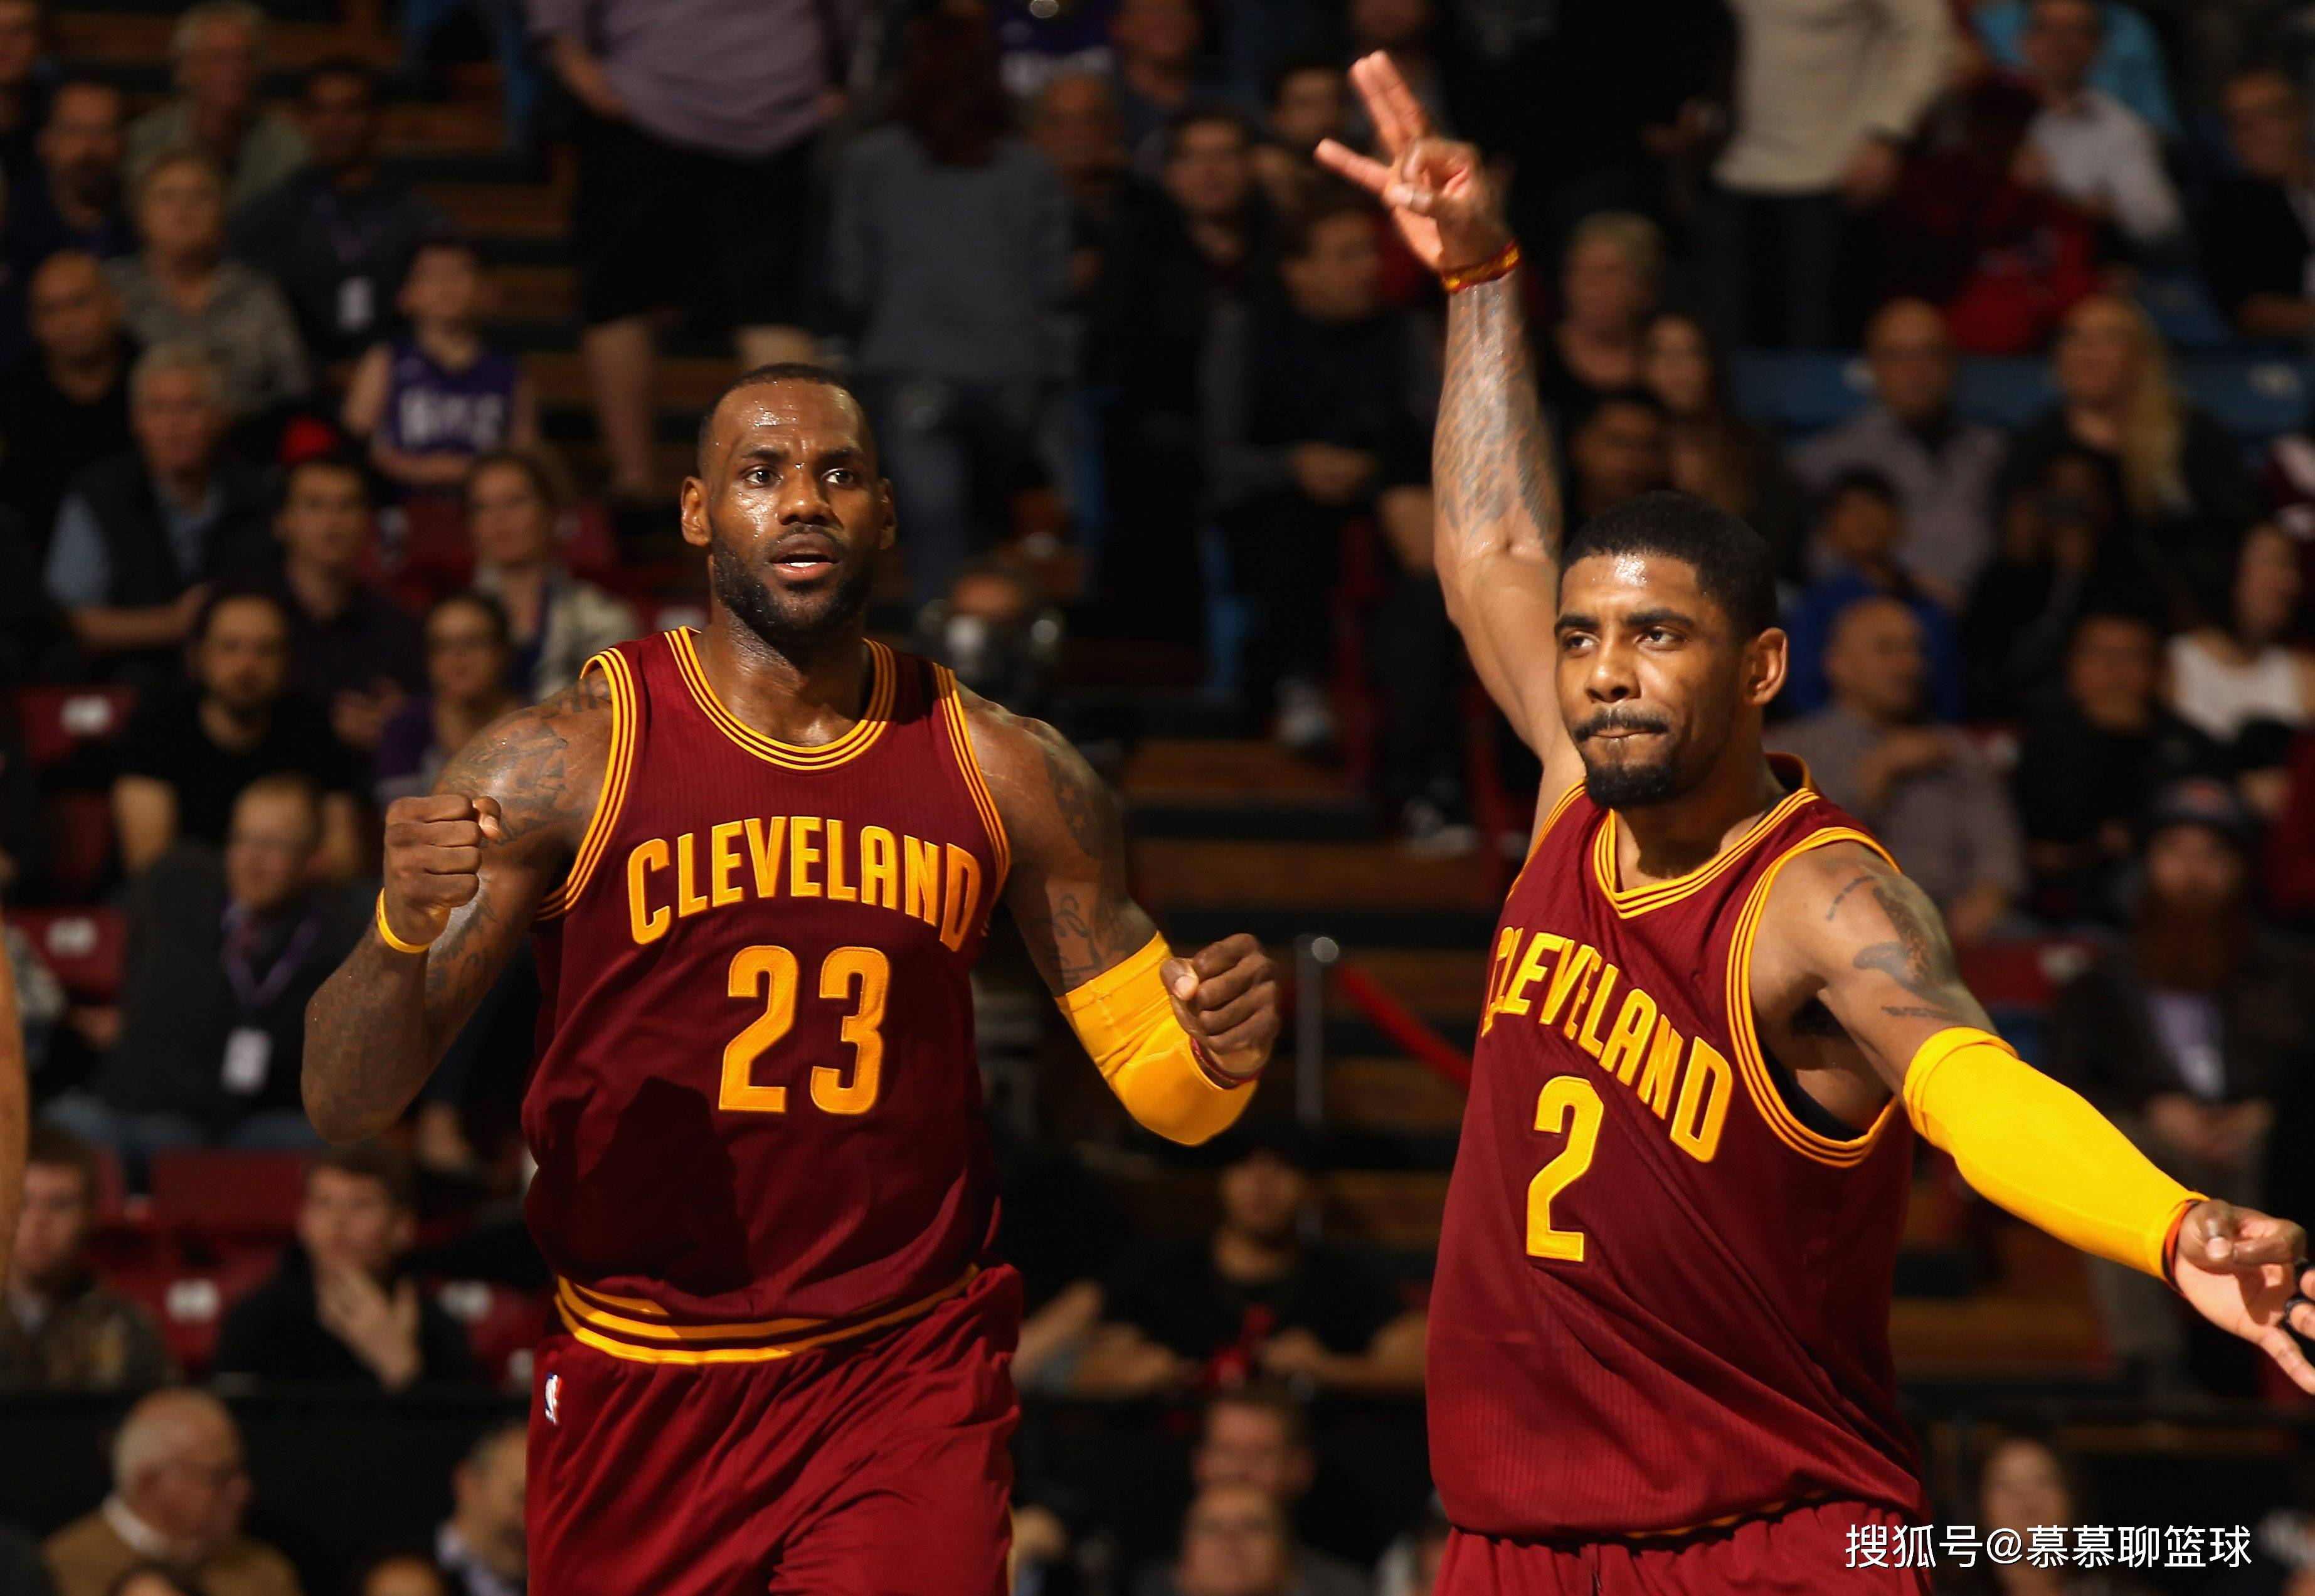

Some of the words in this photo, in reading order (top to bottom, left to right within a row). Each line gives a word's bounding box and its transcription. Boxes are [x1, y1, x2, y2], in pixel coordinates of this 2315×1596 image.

[627, 816, 981, 951] CLEVELAND
[719, 945, 890, 1114] 23
[1526, 1075, 1604, 1262] 2
